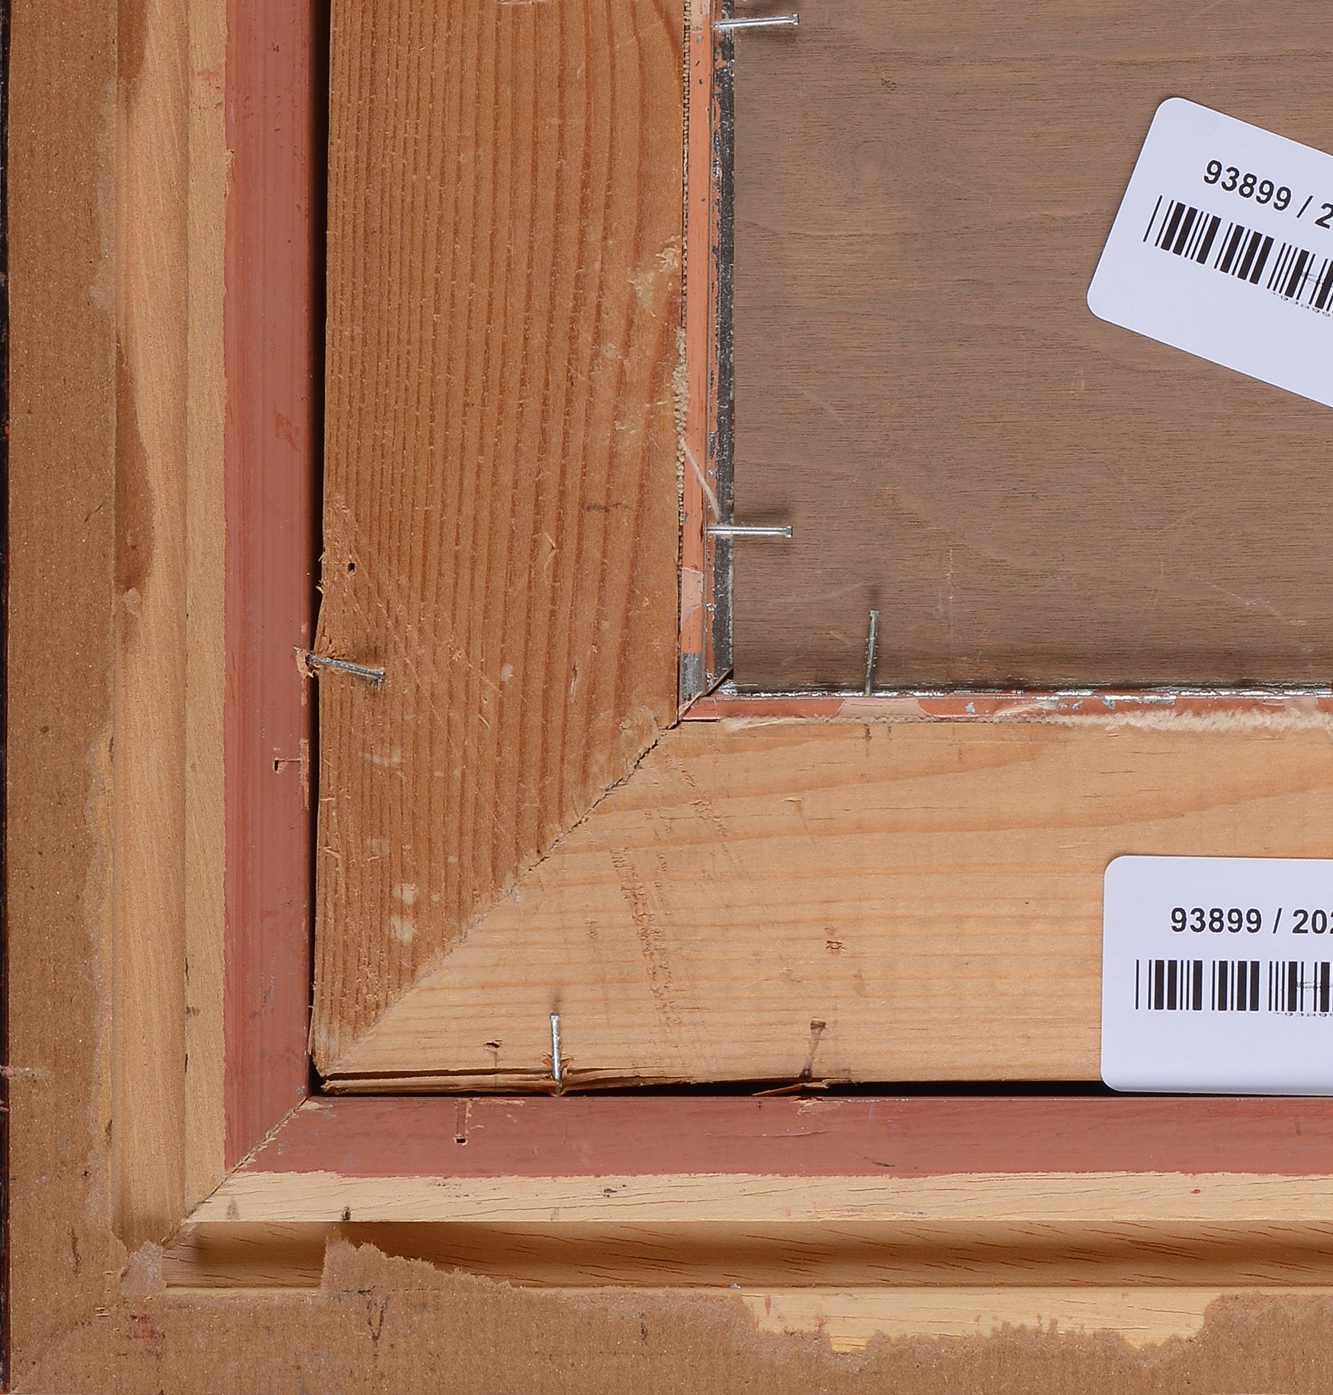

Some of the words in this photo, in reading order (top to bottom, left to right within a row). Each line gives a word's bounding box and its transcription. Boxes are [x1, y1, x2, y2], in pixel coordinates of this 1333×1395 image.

[1203, 158, 1293, 213] 93899
[1296, 194, 1314, 220] /
[1170, 906, 1263, 935] 93899
[1271, 907, 1283, 935] /
